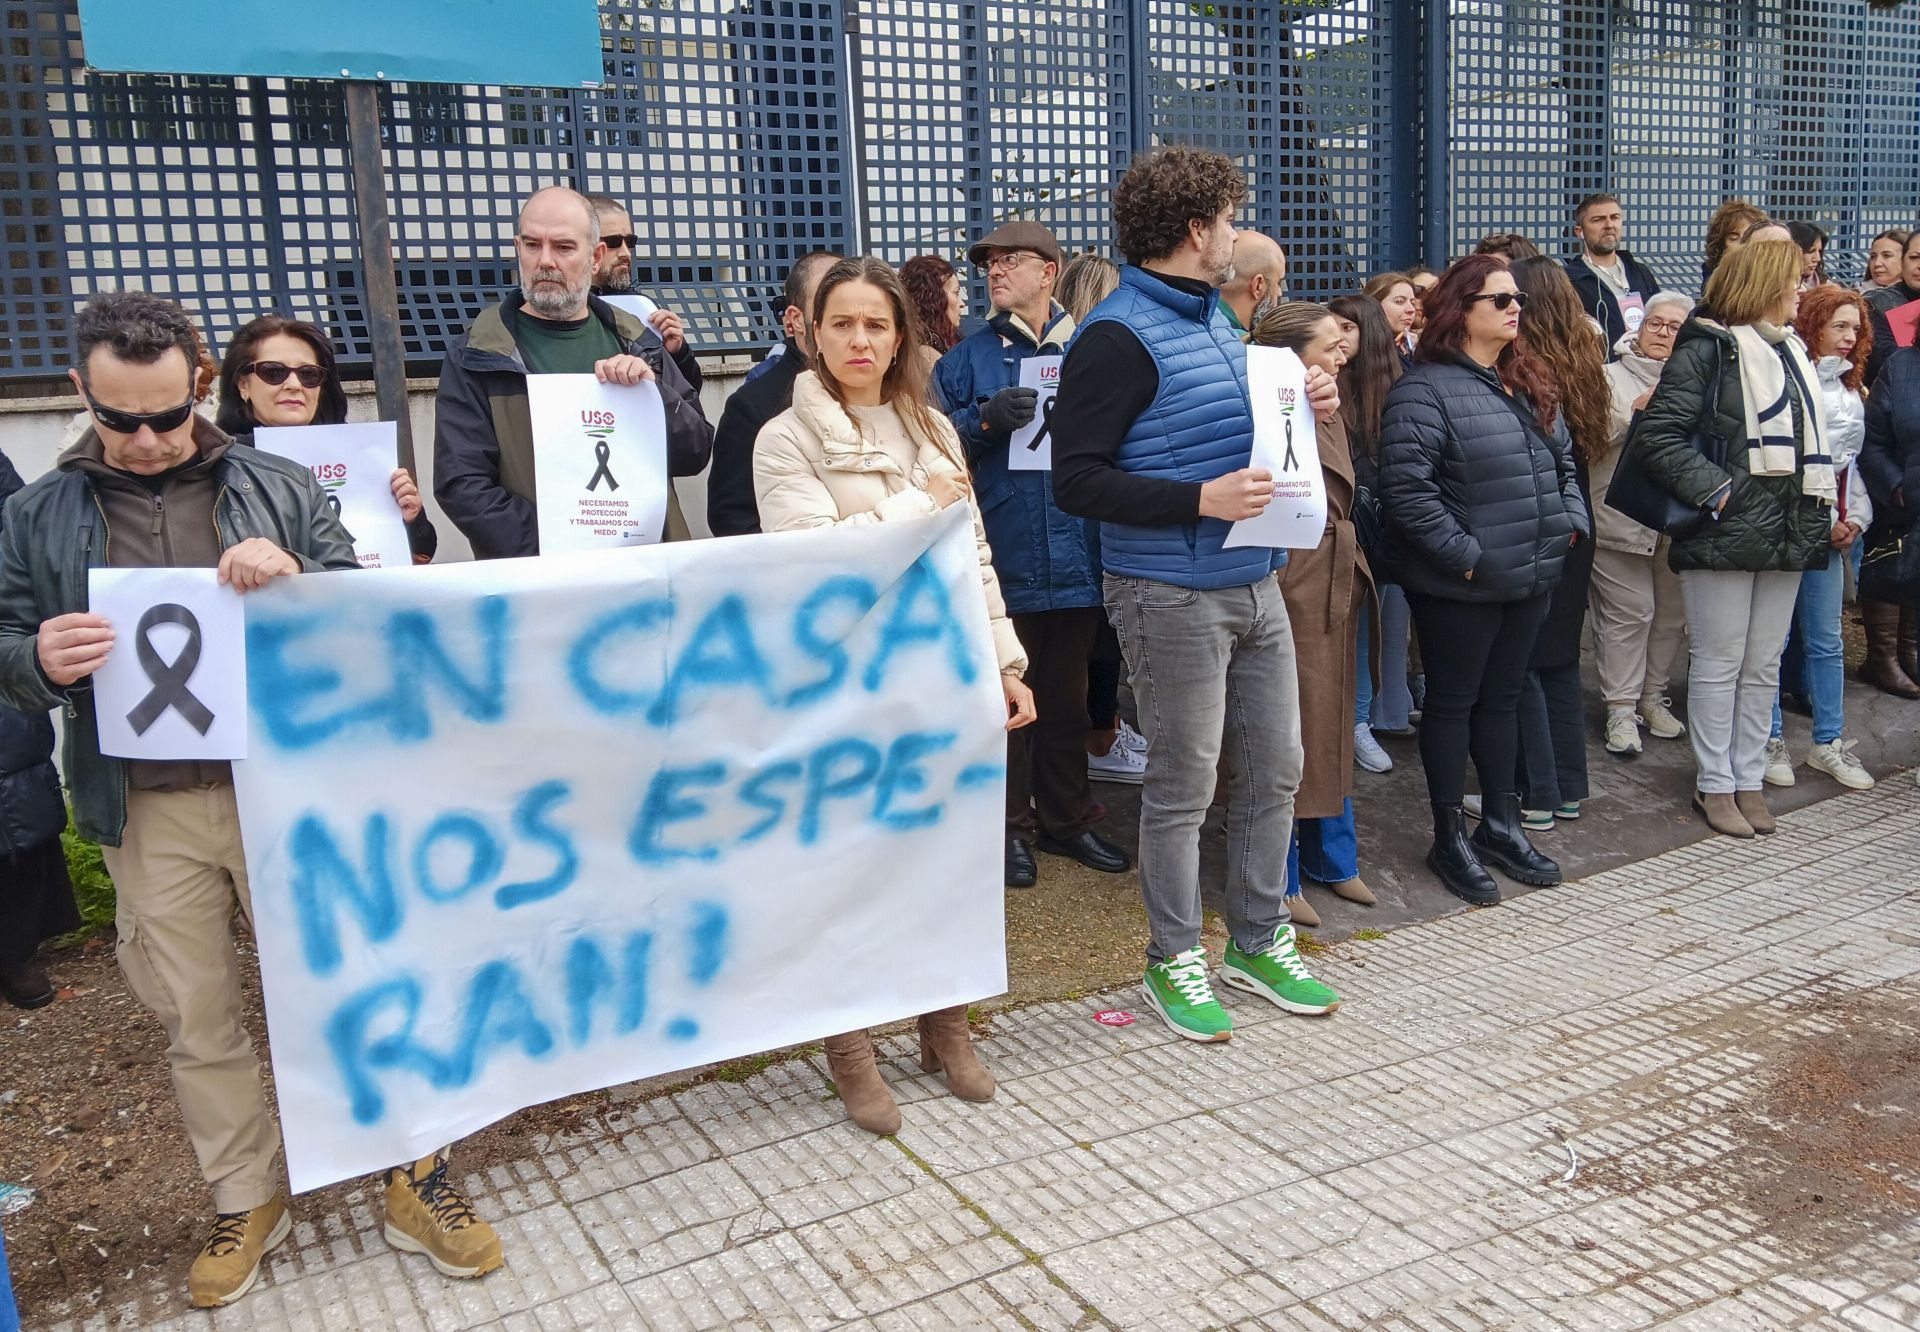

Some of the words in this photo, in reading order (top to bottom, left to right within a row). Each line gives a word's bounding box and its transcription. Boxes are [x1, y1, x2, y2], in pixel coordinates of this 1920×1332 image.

[1041, 366, 1058, 378] US
[1278, 387, 1295, 402] USO
[581, 410, 615, 425] USO
[311, 463, 346, 478] USO
[579, 499, 629, 508] NECESITAMOS
[581, 508, 627, 517] PROTECCIÓN
[569, 518, 575, 526] Y
[576, 518, 622, 527] TRABAJAMOS
[594, 528, 617, 536] MIEDO
[247, 595, 508, 750] EN
[568, 555, 977, 727] CASA
[288, 780, 578, 975] NOS
[627, 732, 1002, 866] ESPE-
[325, 898, 732, 1126] RAN!
